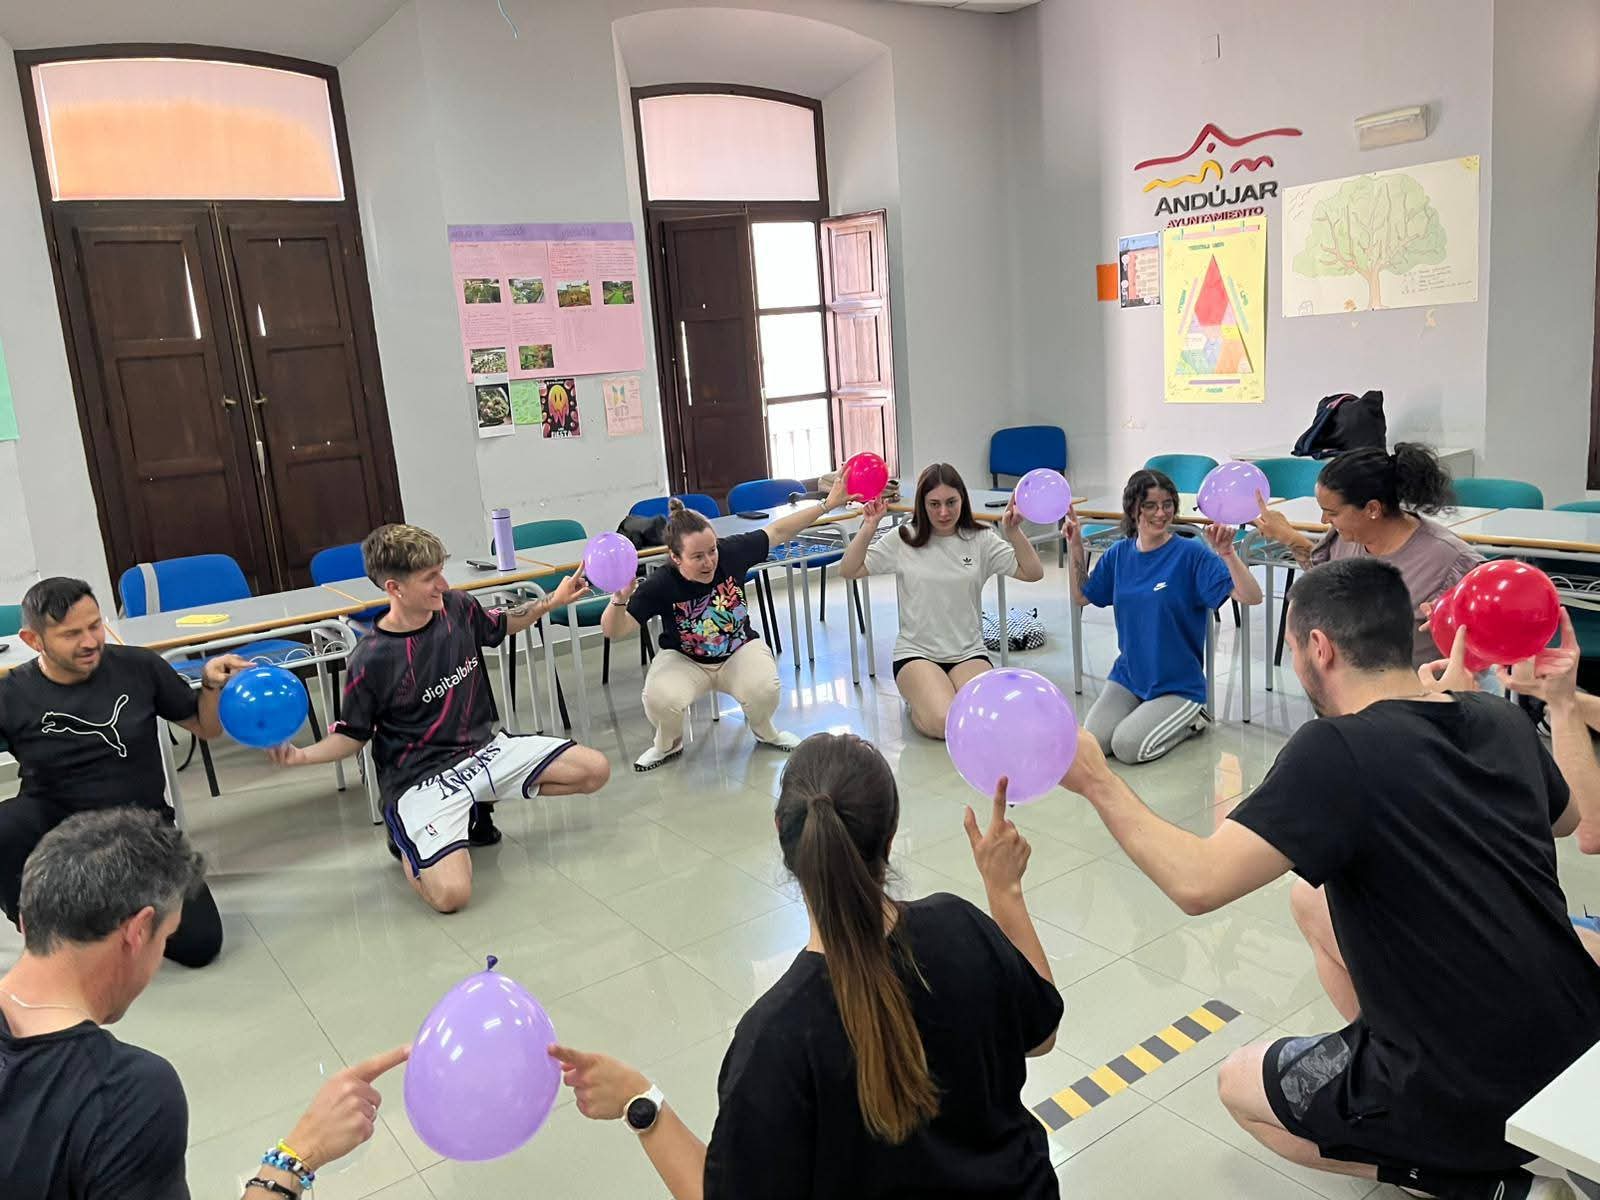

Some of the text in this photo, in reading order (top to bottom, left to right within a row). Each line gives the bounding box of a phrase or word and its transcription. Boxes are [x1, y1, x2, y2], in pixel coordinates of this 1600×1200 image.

[1154, 181, 1278, 216] ANDÚJAR
[1166, 206, 1264, 228] AYUNTAMIENTO
[422, 657, 478, 703] digitalbits
